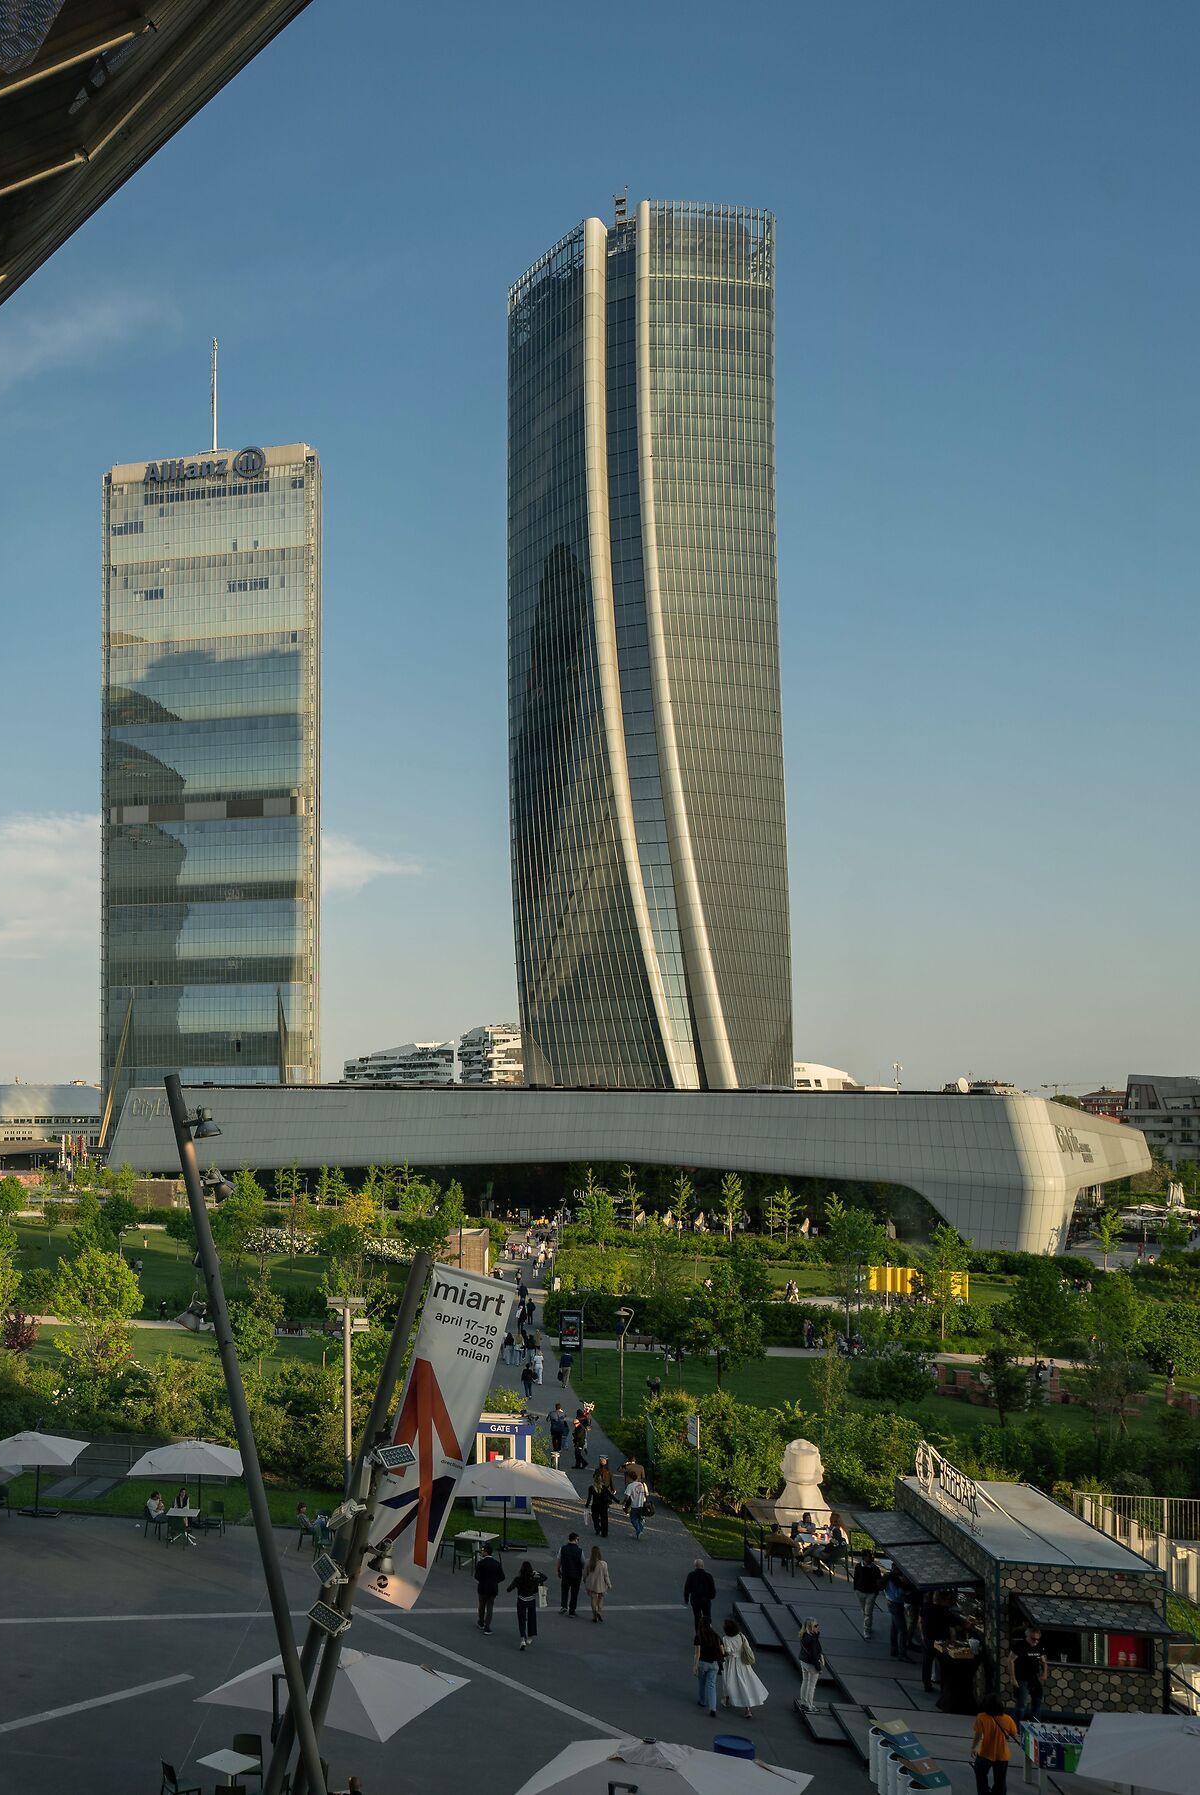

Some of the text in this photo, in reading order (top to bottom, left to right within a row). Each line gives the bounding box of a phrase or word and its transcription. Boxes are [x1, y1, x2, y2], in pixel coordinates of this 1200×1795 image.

[144, 458, 228, 483] Allianz
[433, 1282, 505, 1317] miart
[435, 1312, 463, 1327] april
[462, 1332, 494, 1350] 2026
[456, 1347, 490, 1364] milan
[490, 1424, 511, 1433] GATE
